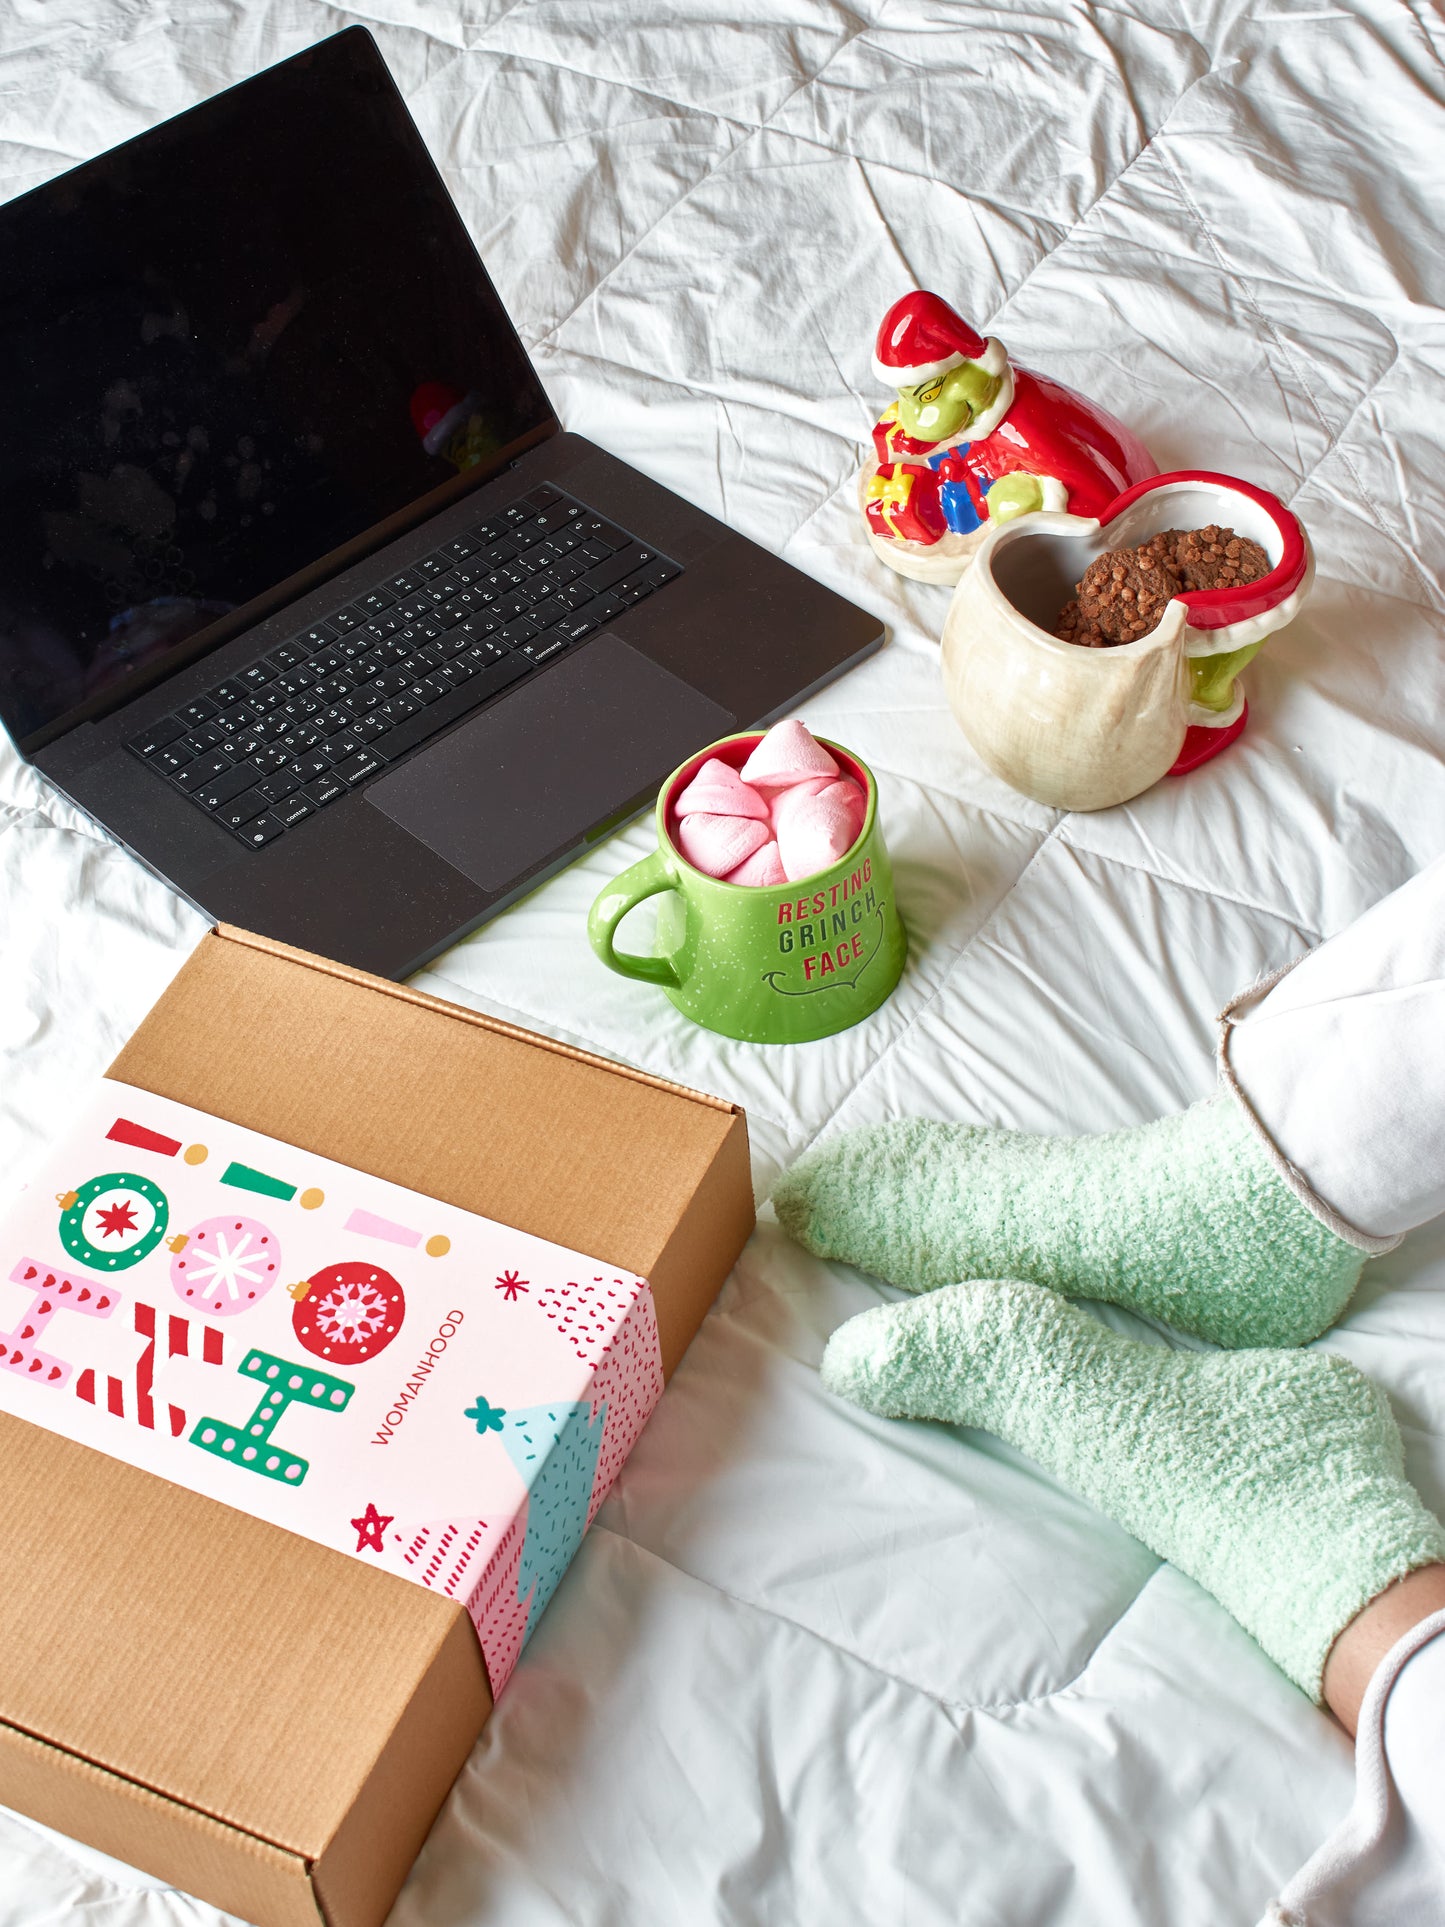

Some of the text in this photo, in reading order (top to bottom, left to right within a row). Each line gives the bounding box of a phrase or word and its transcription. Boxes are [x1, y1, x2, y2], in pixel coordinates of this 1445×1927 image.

[571, 625, 588, 636] option
[536, 642, 561, 659] command
[349, 761, 376, 780] command
[320, 787, 338, 800] option
[287, 807, 307, 821] control
[777, 857, 872, 925] RESTING
[779, 886, 877, 954] GRINCH
[803, 932, 865, 981] FACE
[370, 1308, 465, 1446] WOMANHOOD
